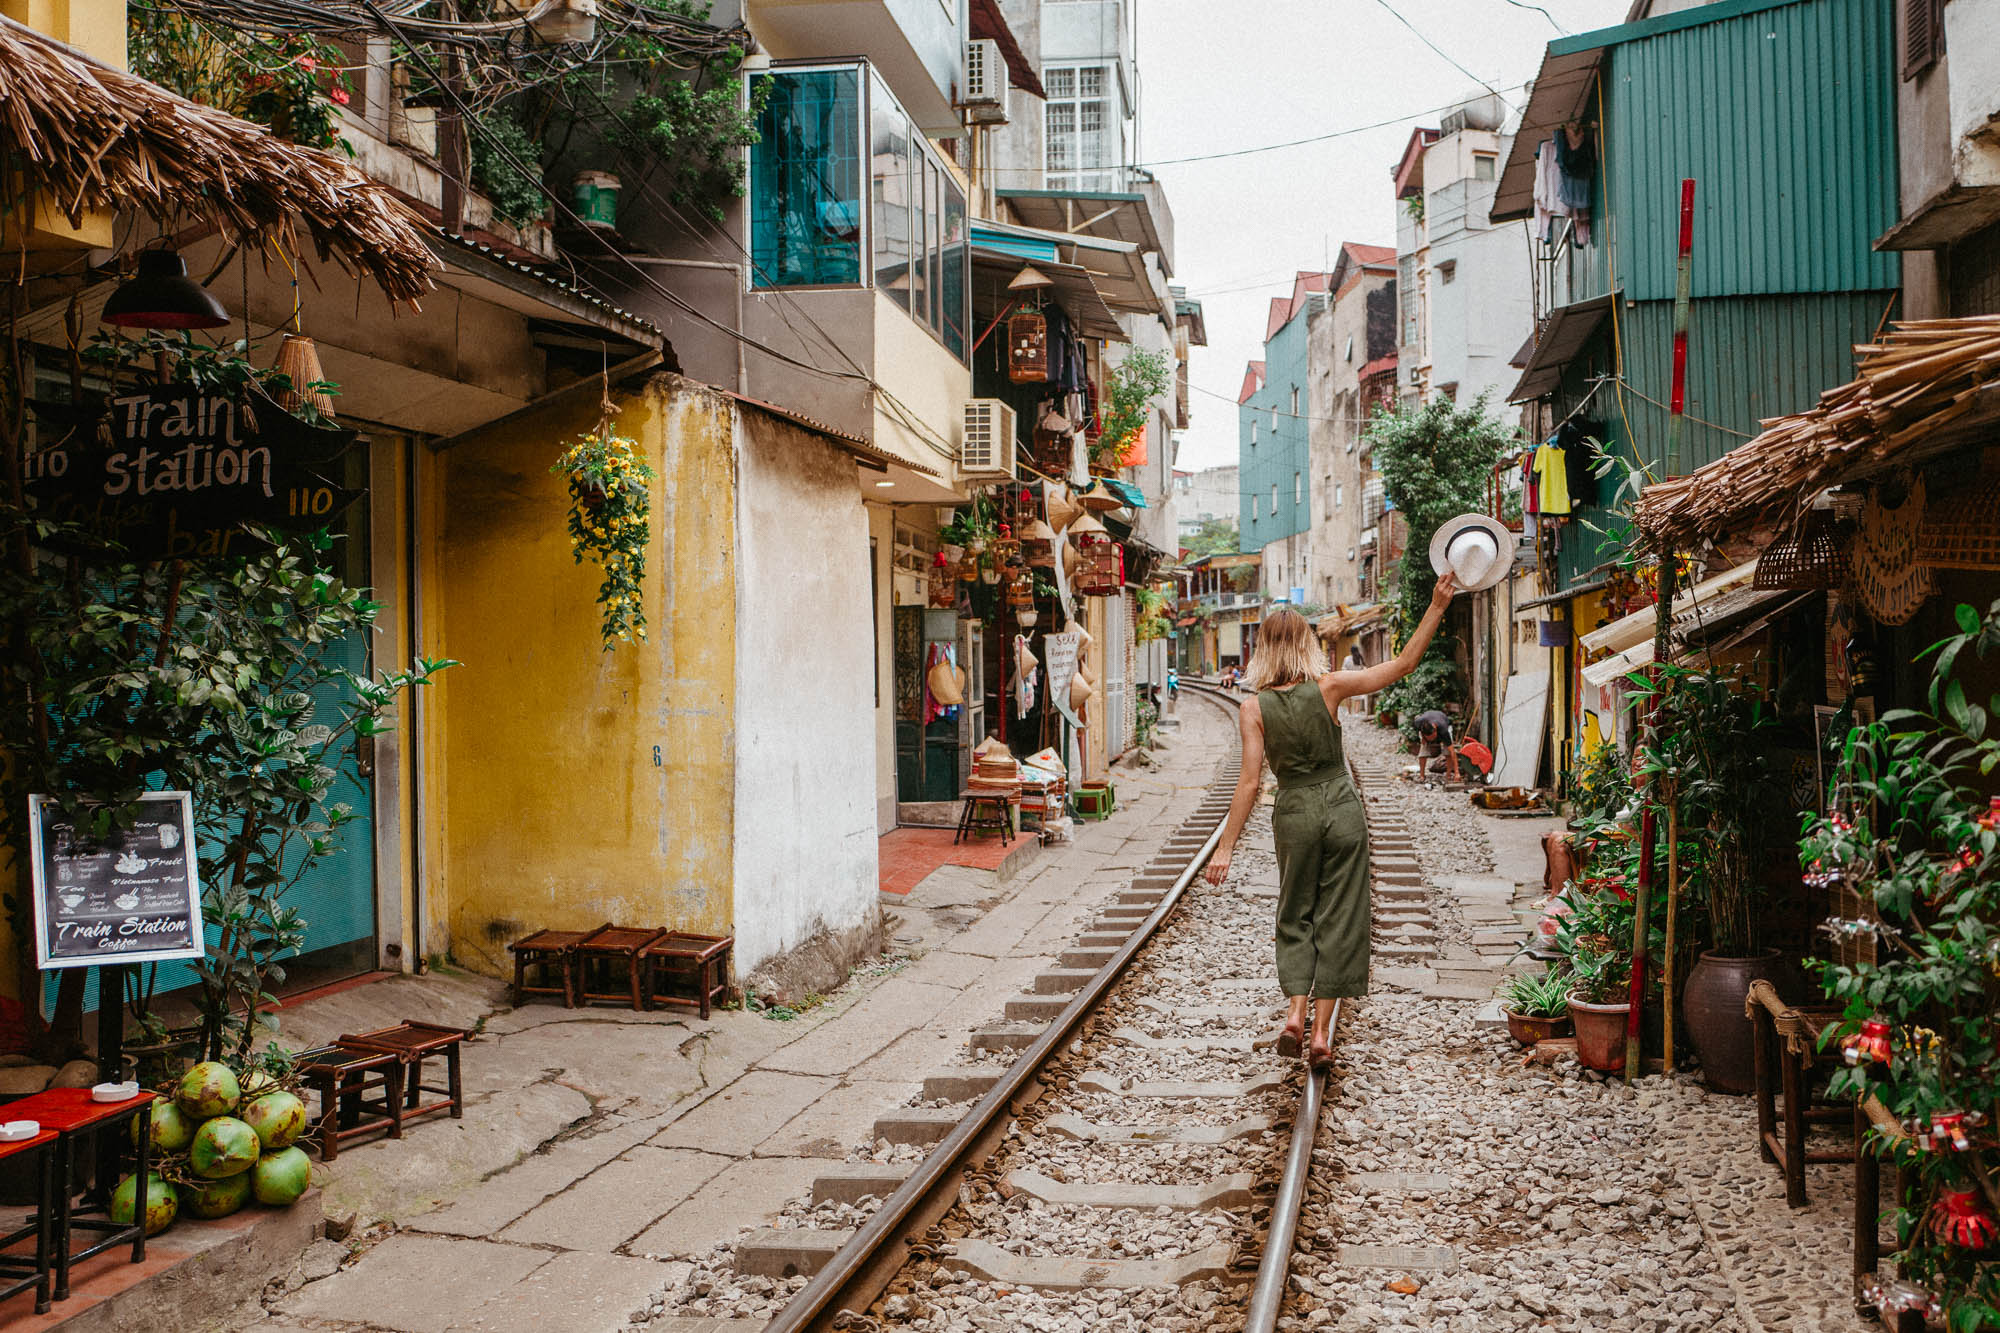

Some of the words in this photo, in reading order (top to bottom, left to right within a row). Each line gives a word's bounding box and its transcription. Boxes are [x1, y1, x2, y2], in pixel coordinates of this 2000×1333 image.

[113, 389, 244, 447] Train
[289, 487, 333, 517] 110
[167, 506, 245, 560] bar
[1890, 565, 1930, 610] STATIO
[147, 857, 183, 867] Fruit
[56, 885, 86, 893] Tea
[111, 878, 160, 886] Vietnamese
[55, 920, 112, 940] Train
[119, 916, 187, 936] Station
[98, 937, 138, 950] Coffee
